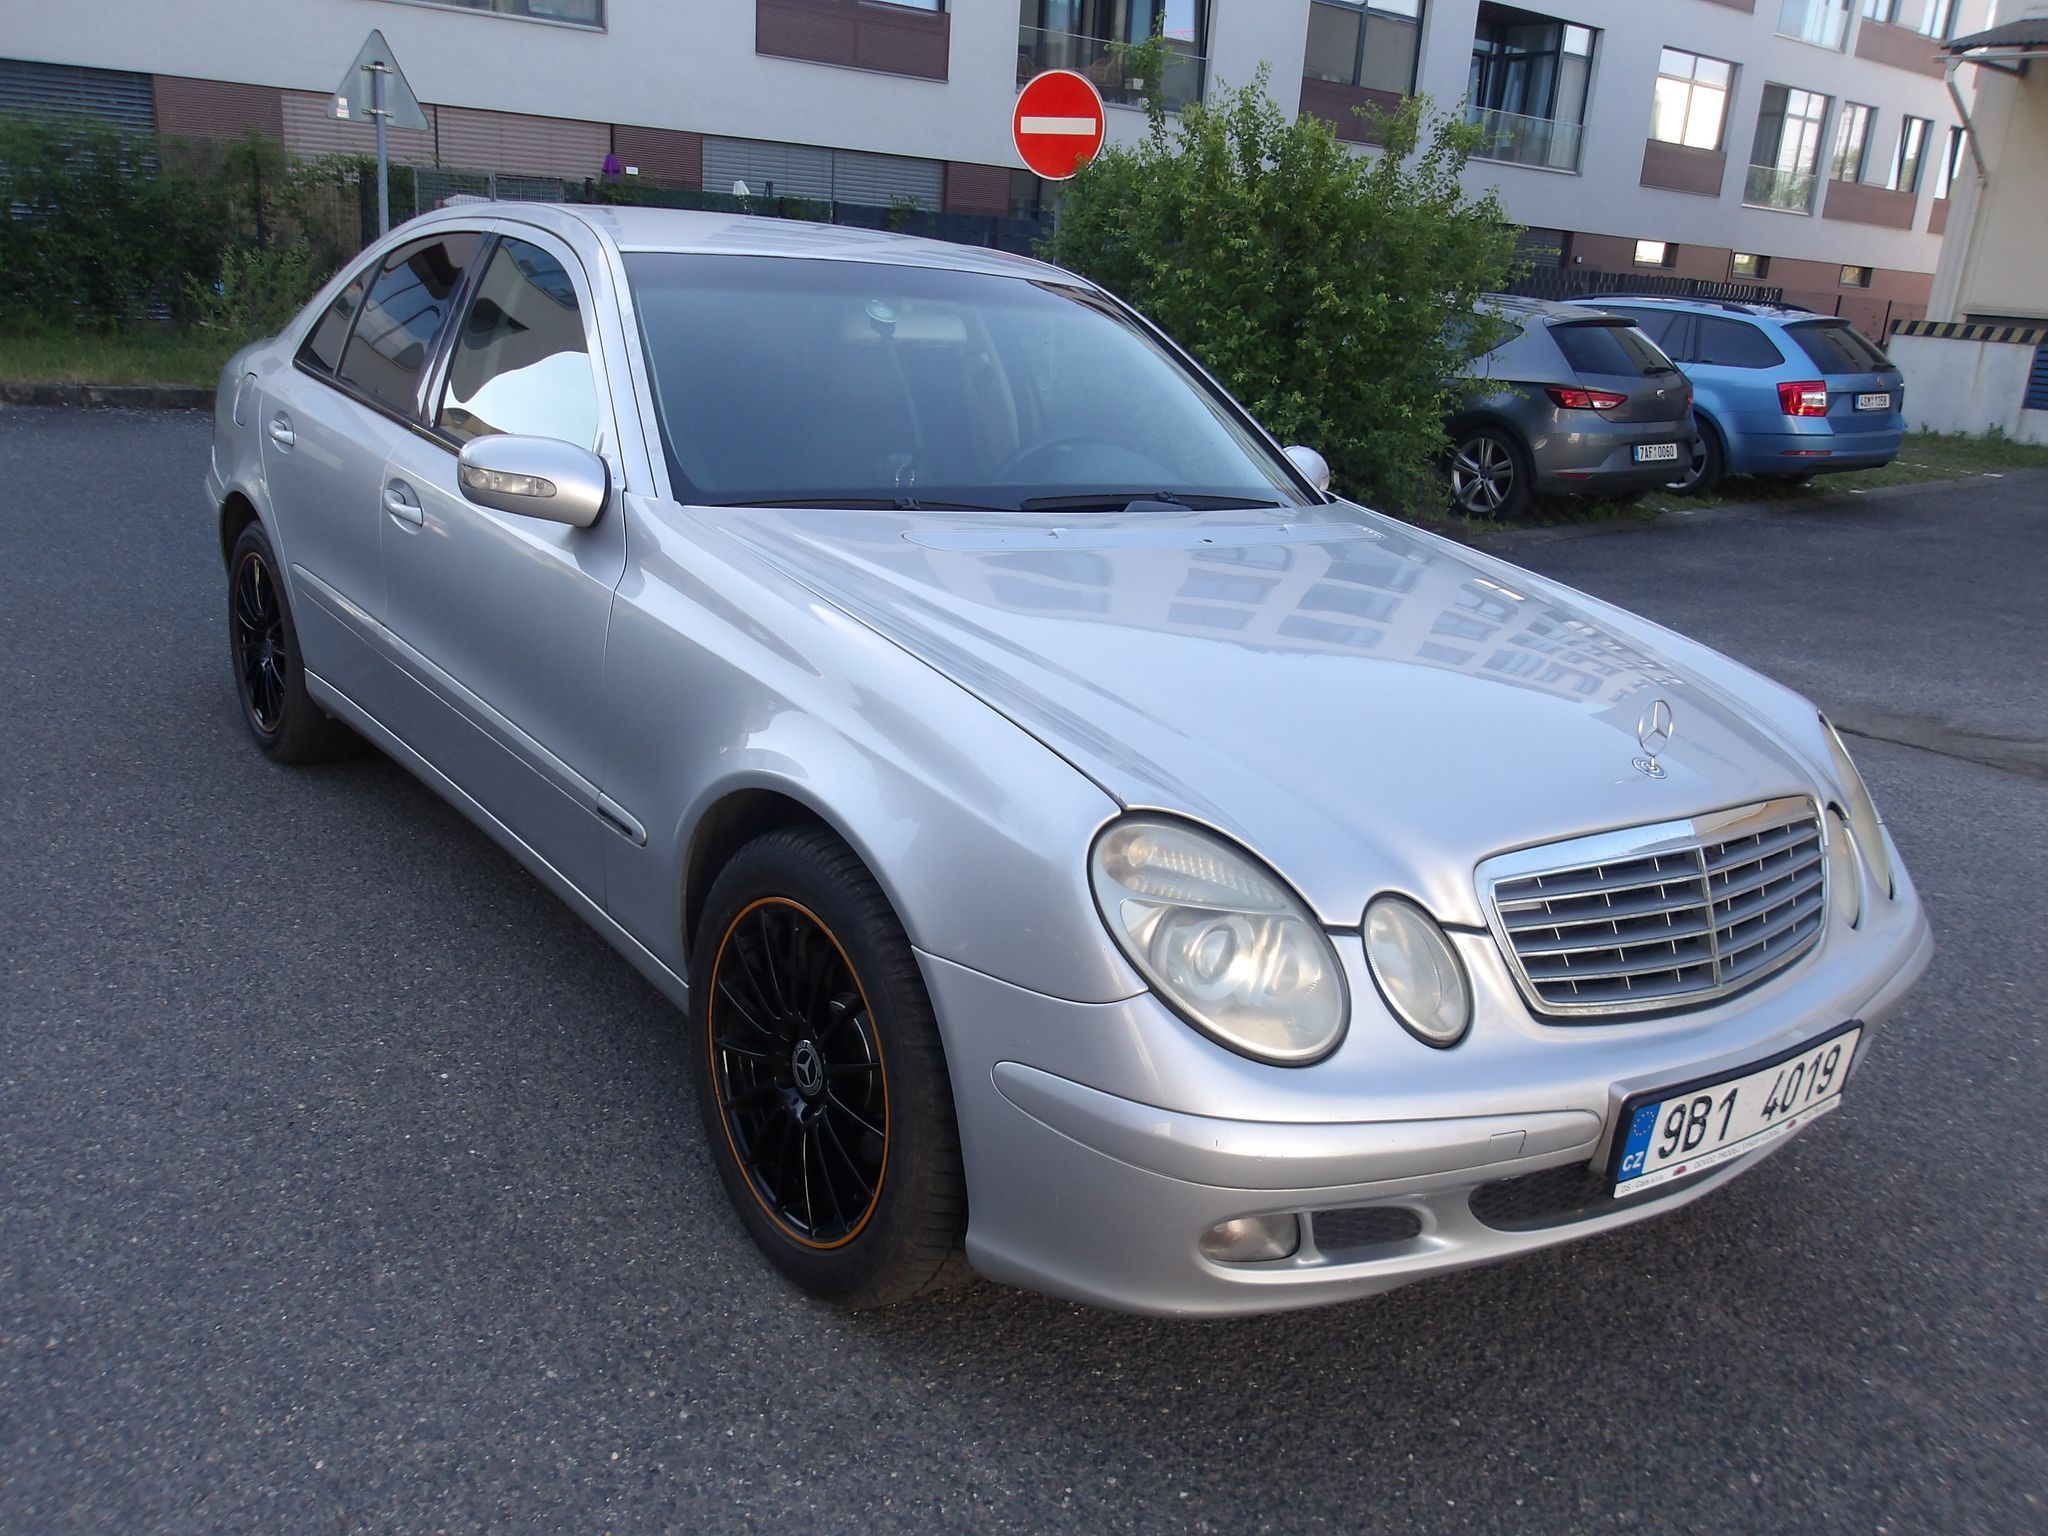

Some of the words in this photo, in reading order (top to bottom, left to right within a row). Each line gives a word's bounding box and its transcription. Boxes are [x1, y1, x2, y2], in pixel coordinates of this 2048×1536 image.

[1657, 1087, 1739, 1159] 9B1
[1761, 1044, 1841, 1121] 4019
[1622, 1151, 1644, 1171] CZ
